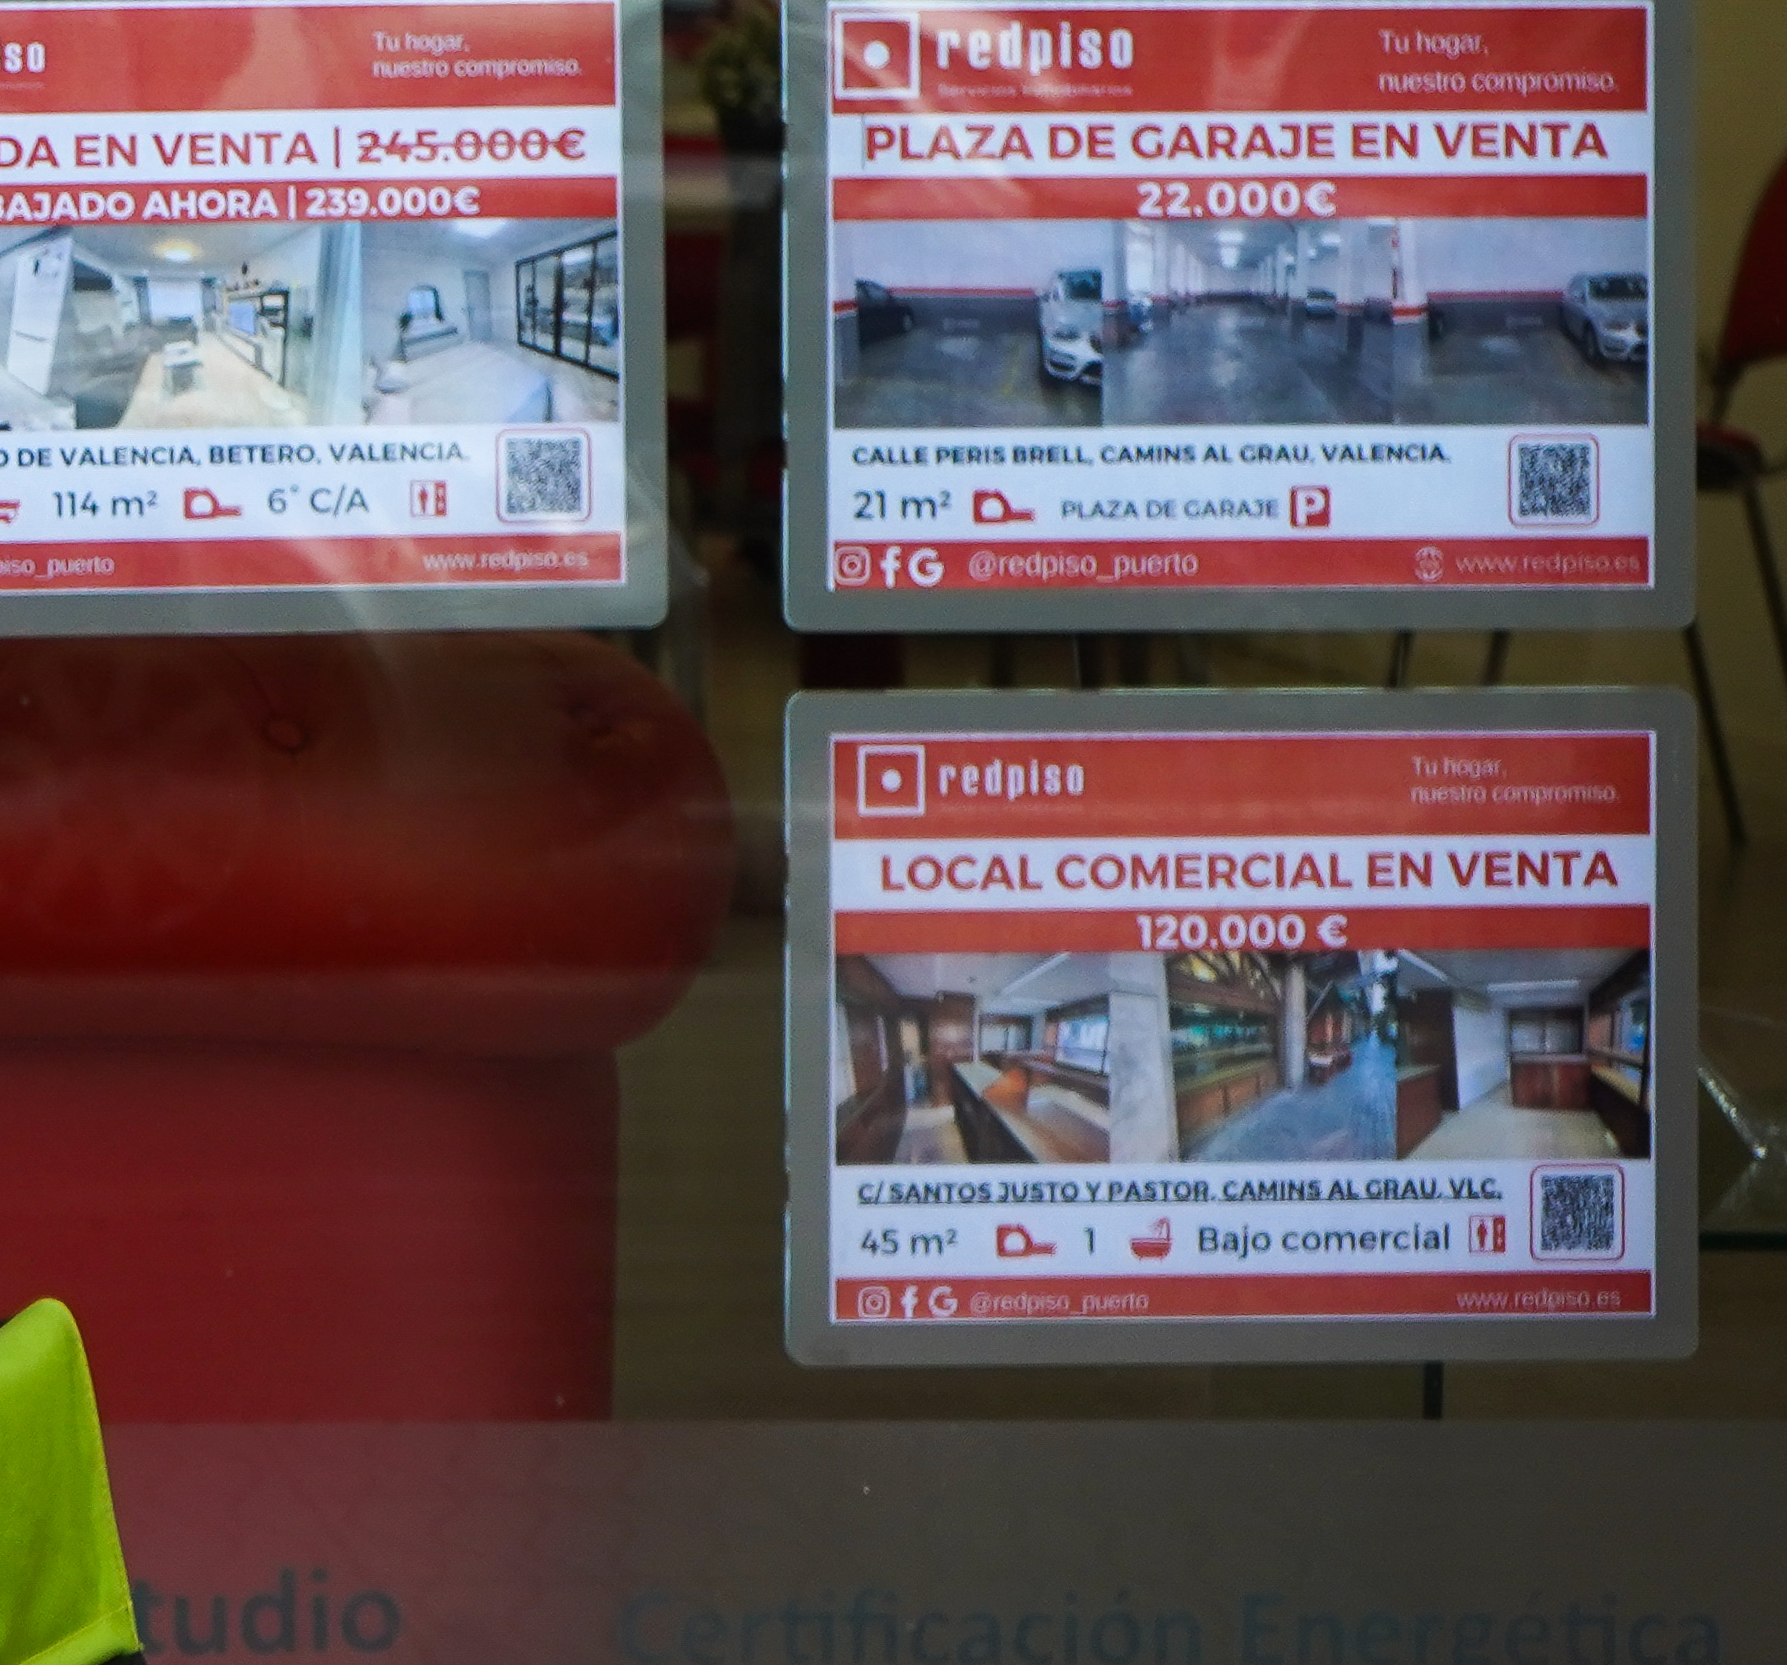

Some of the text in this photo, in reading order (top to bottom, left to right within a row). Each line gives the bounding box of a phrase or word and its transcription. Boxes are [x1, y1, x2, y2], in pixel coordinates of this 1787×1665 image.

[74, 134, 138, 168] EN
[152, 132, 318, 167] VENTA
[357, 127, 586, 164] 245.000€
[865, 121, 1609, 161] PLAZA DE GARAJE EN VENTA
[142, 188, 282, 225] AHORA
[306, 185, 484, 222] 239.000€
[1137, 181, 1336, 217] 22.000€
[881, 849, 1620, 891] LOCAL COMERCIAL EN VENTA
[1136, 913, 1347, 949] 120.000 €
[1198, 1222, 1451, 1259] Bajo comercial
[132, 1568, 402, 1656] tudio
[618, 1587, 1204, 1665] Certificación
